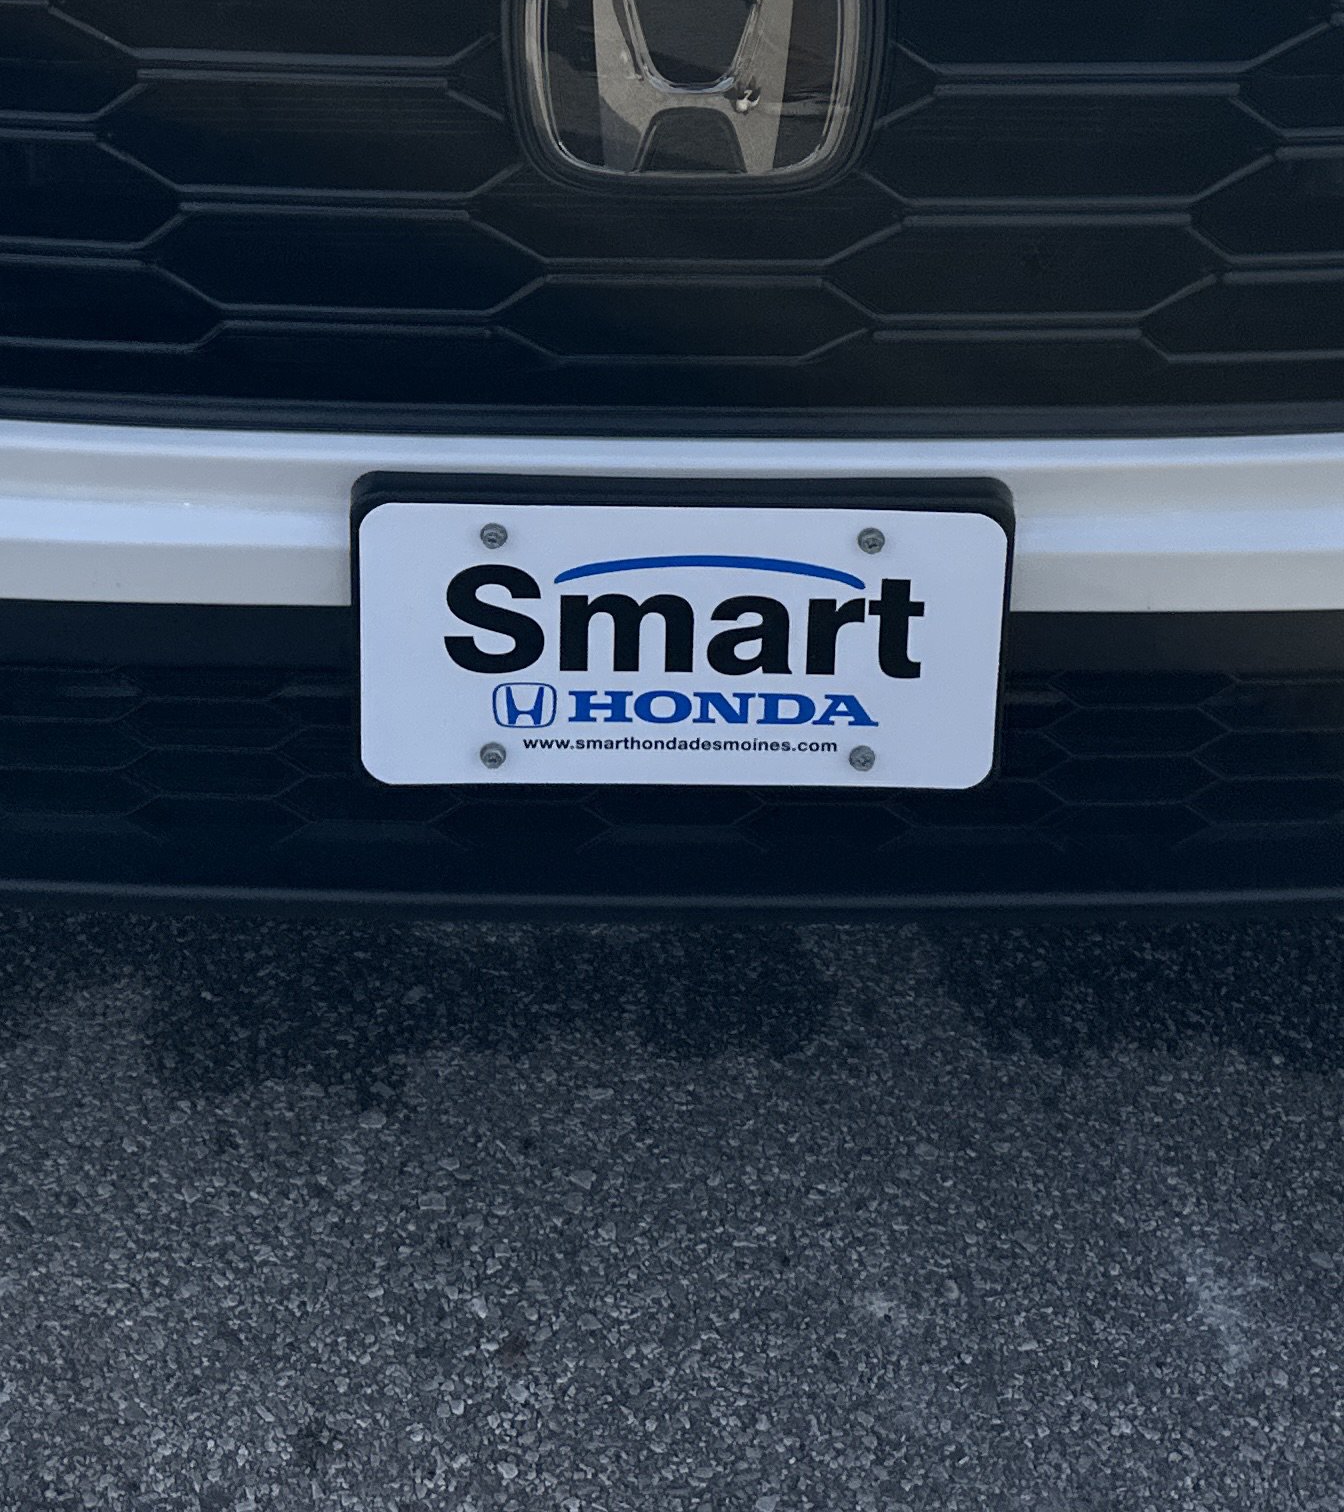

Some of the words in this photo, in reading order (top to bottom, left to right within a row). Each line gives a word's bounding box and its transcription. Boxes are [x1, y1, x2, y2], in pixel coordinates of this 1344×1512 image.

[444, 564, 925, 680] Smart
[567, 690, 879, 727] HONDA
[522, 736, 838, 753] www.smarthondadesmoines.com
